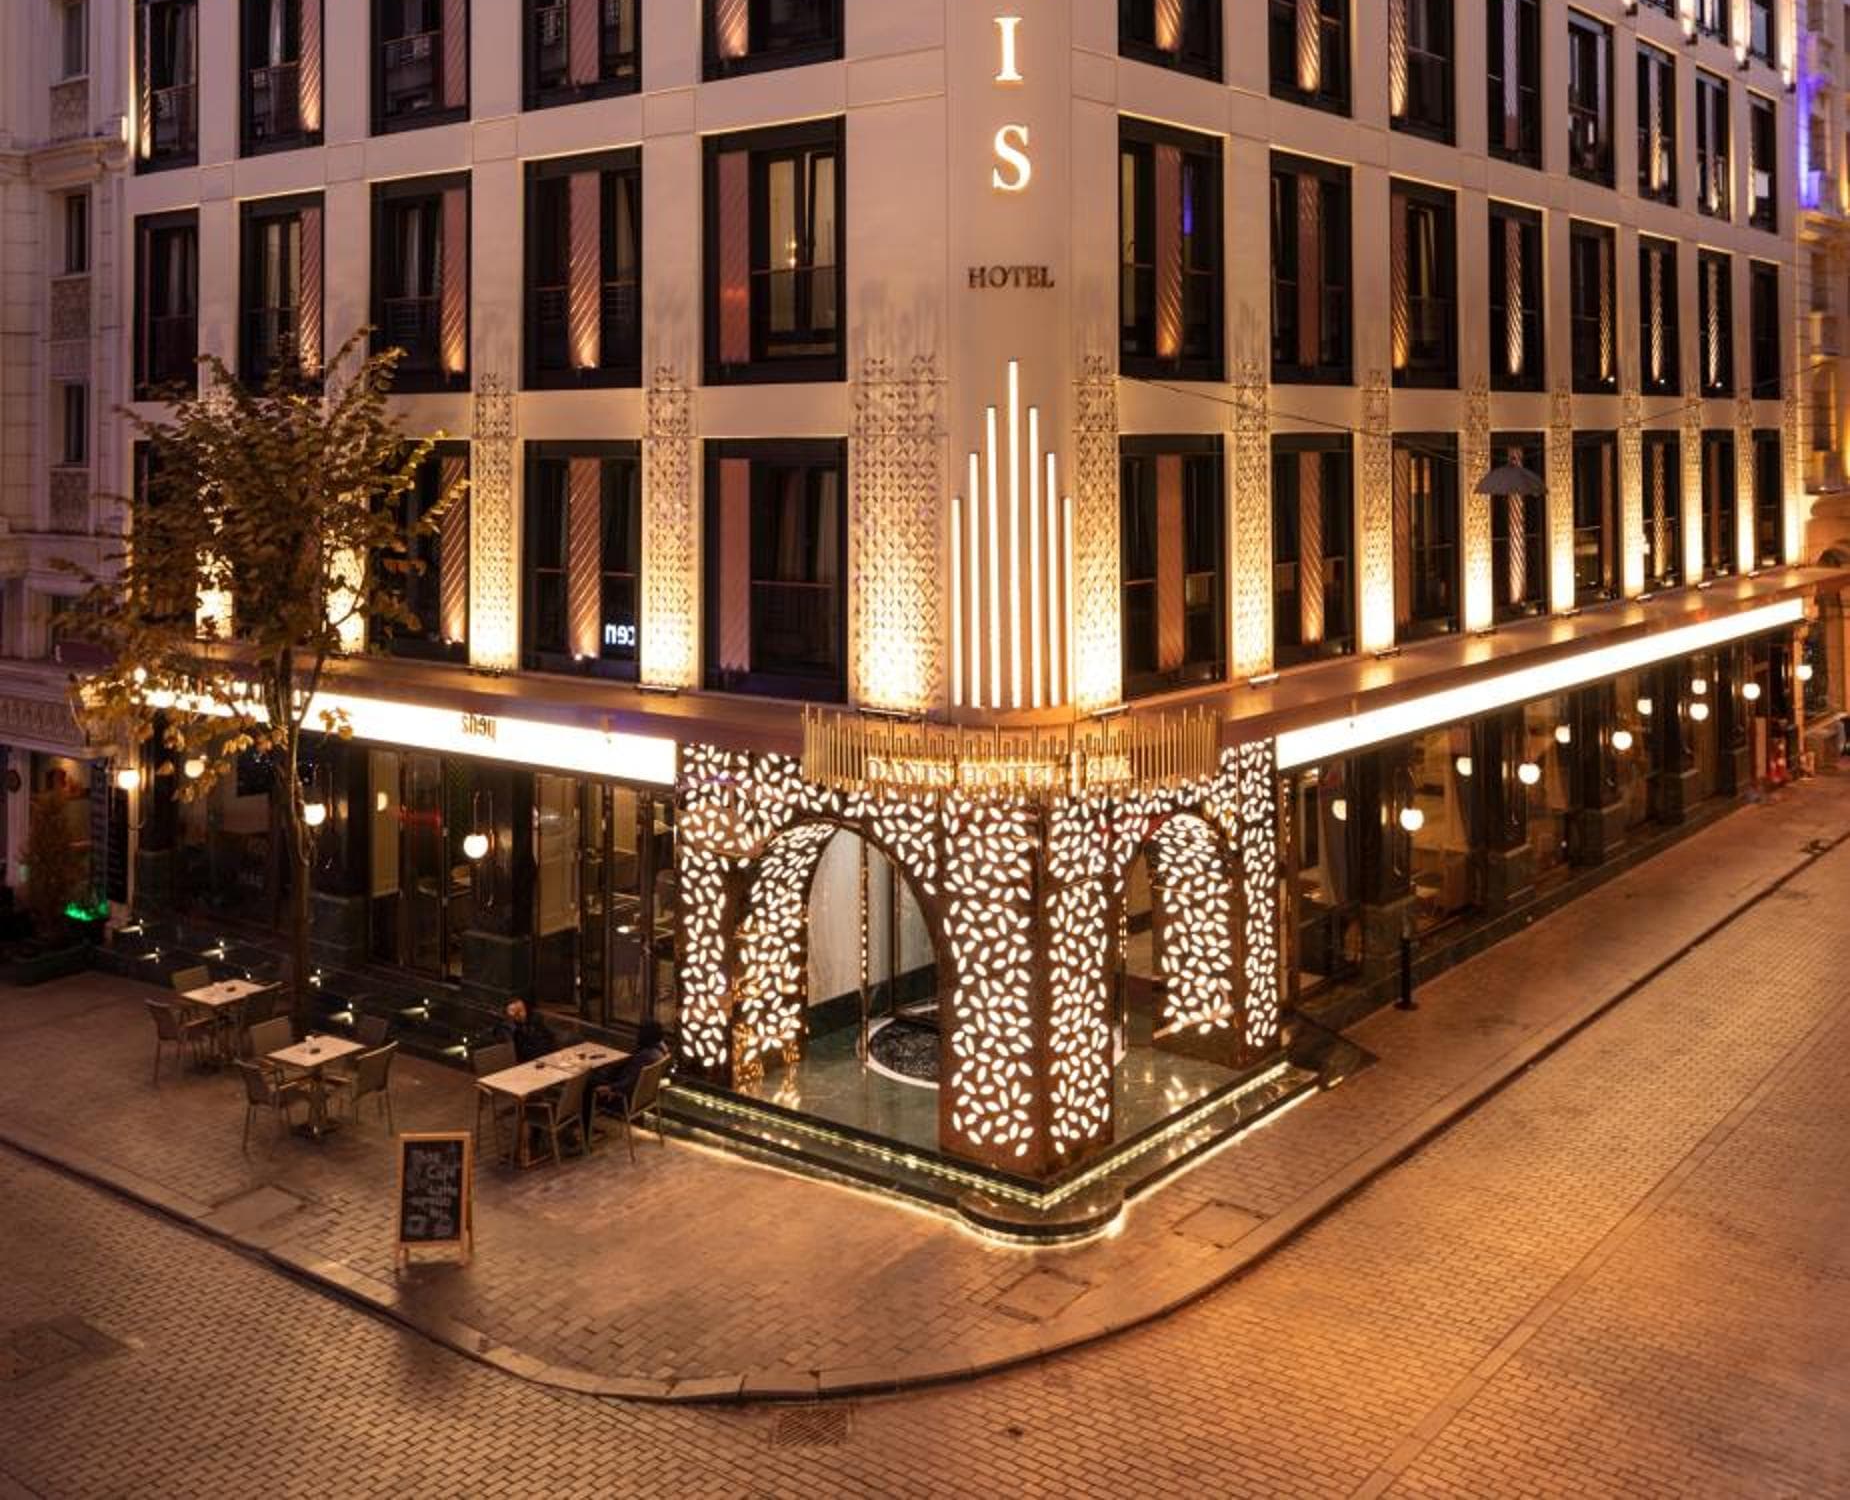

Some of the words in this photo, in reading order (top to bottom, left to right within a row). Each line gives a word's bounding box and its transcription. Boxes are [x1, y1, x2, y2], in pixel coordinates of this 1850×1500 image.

[967, 265, 1055, 289] HOTEL
[866, 757, 955, 787] DANIS
[1085, 755, 1130, 781] SPA
